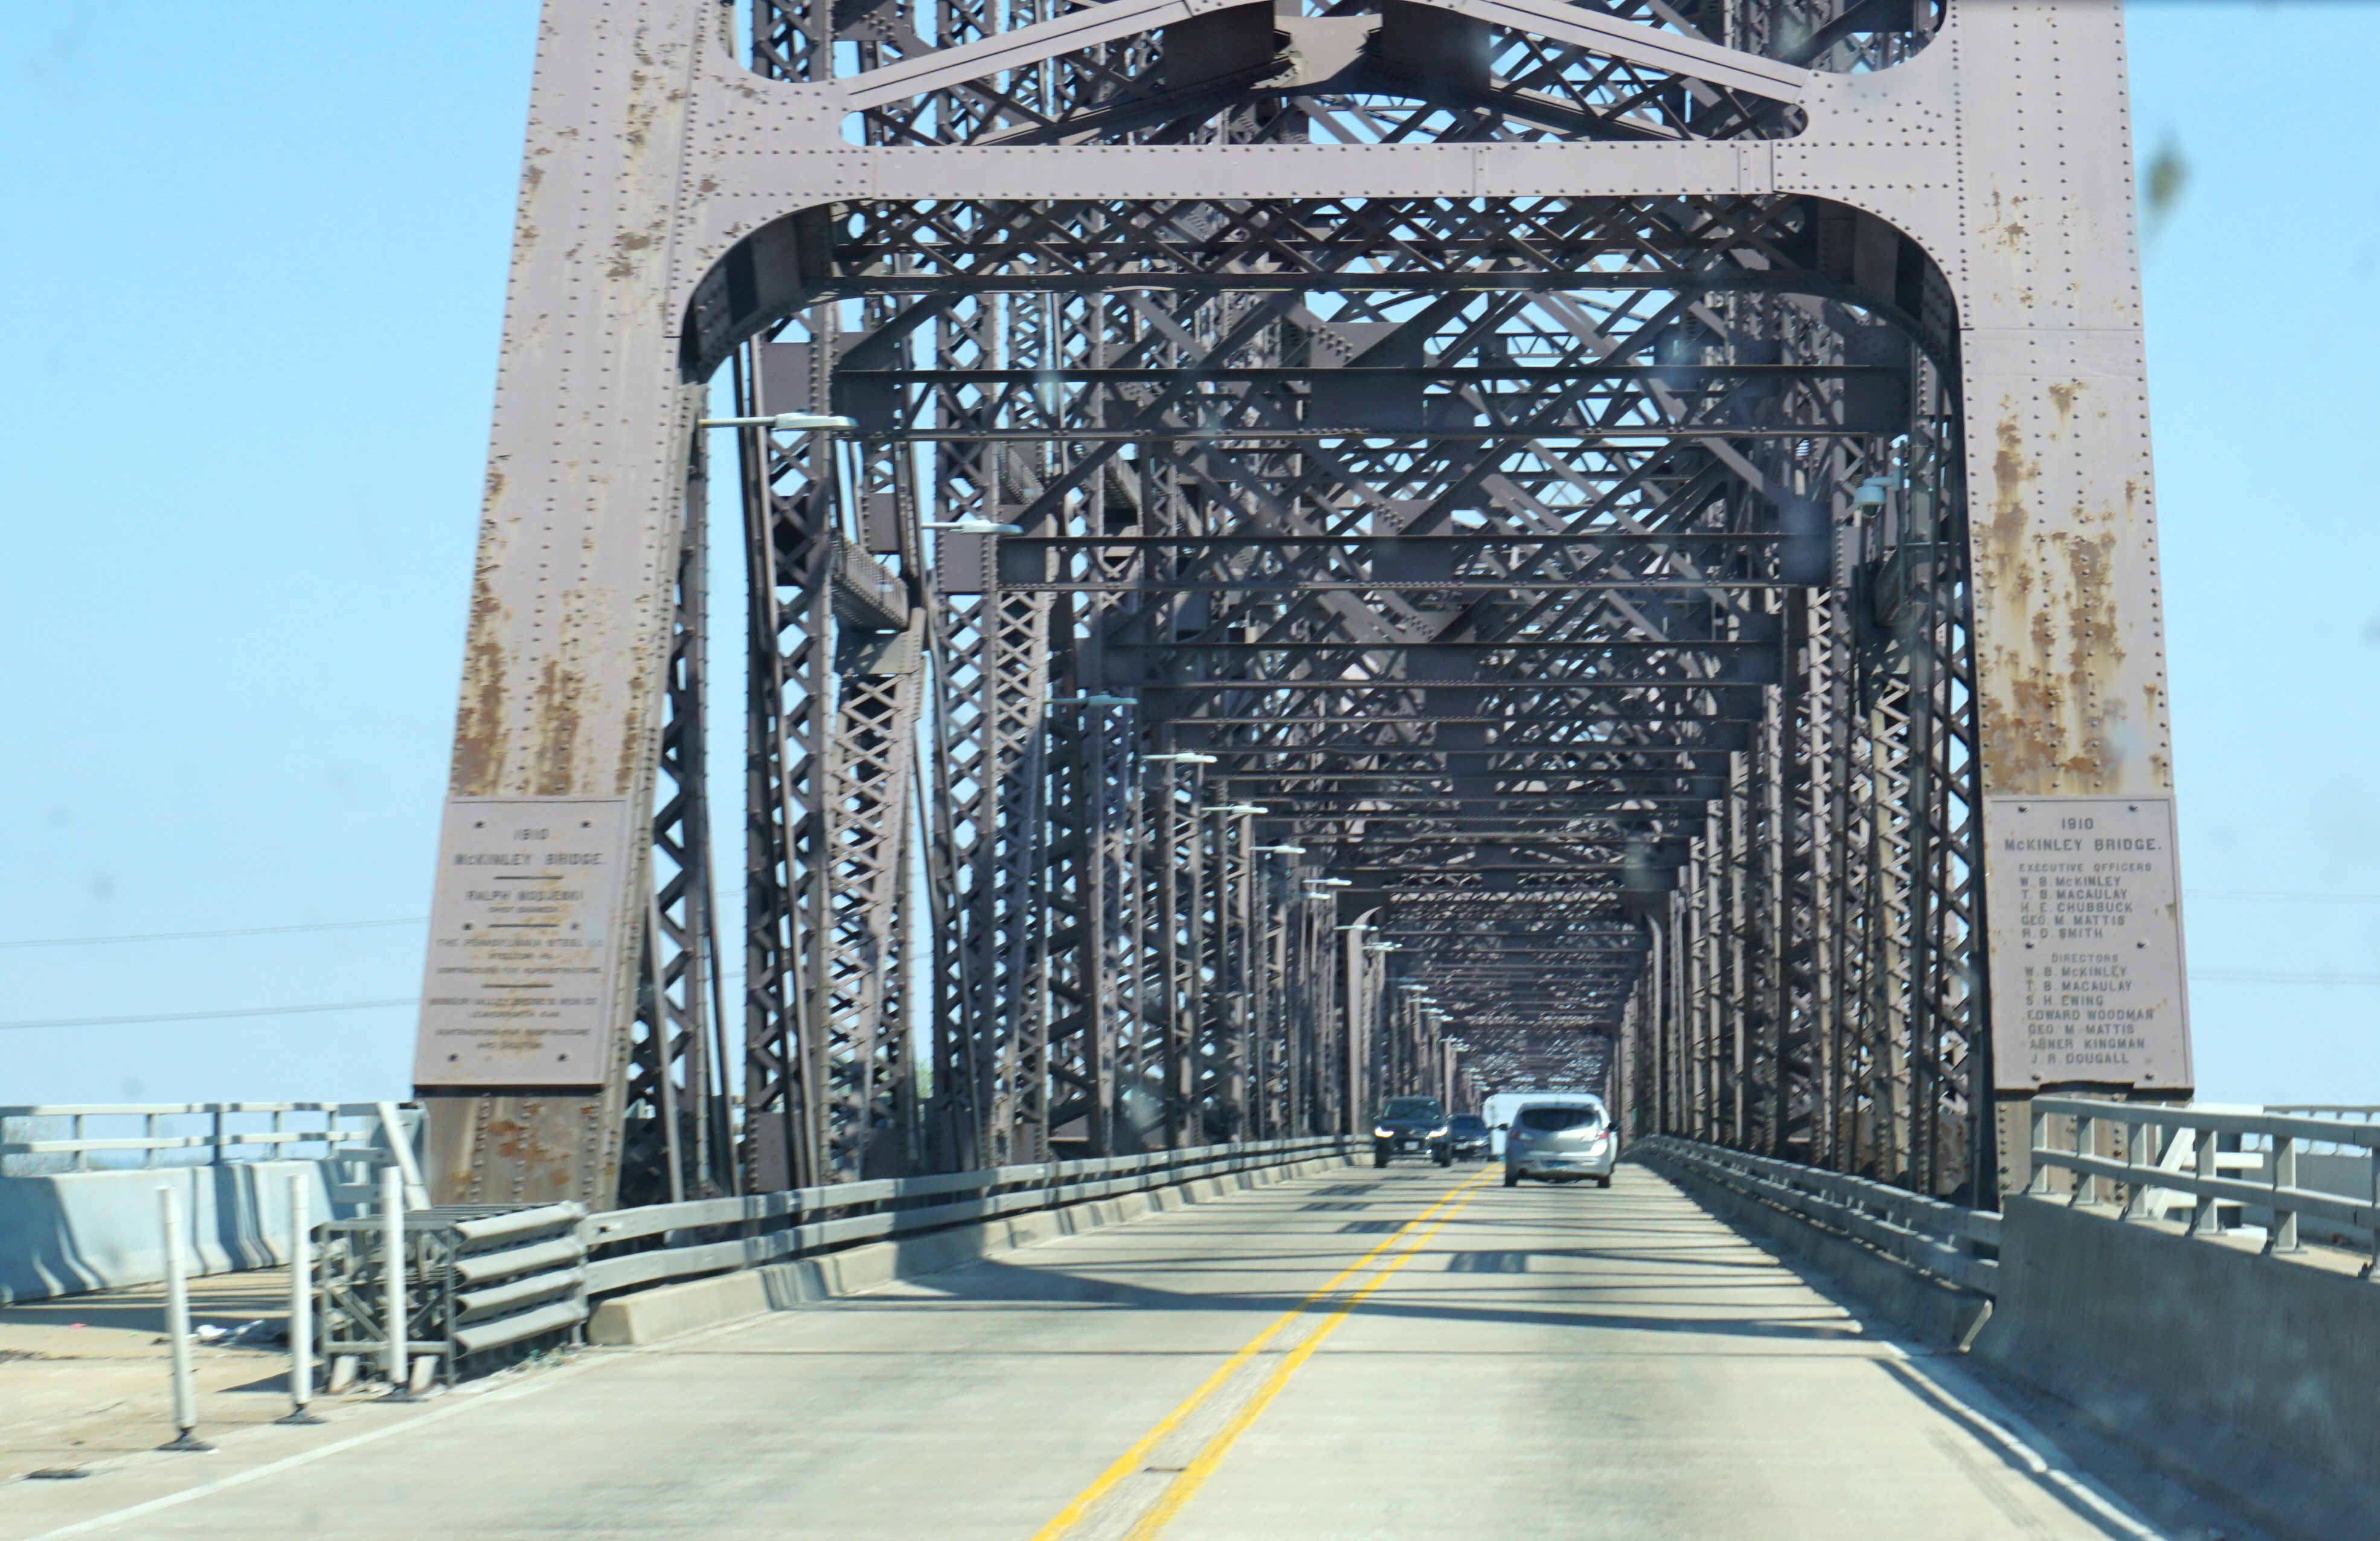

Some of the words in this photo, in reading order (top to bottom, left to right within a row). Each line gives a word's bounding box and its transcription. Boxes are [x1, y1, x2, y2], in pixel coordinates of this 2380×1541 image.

[2061, 817, 2094, 830] 1910
[2004, 838, 2083, 851] McKINLEY
[2094, 838, 2162, 851] BRIDGE.
[2018, 863, 2083, 872] EXECUTIVE
[2093, 863, 2152, 872] OFFICERS
[2055, 876, 2122, 887] McKINLEY
[2056, 889, 2128, 899] MACAULAY
[2056, 902, 2132, 913] CHUBBUCK
[2073, 915, 2126, 925] MATTIS
[2058, 927, 2103, 939] SMITH
[2051, 953, 2119, 963] DIRECTORS
[2061, 966, 2128, 977] McKINLEY
[2061, 980, 2132, 991] MACAULAY
[2061, 994, 2104, 1006] EWING
[2027, 1009, 2080, 1020] EDWARD
[2086, 1009, 2154, 1020] WOODMAN
[2085, 1024, 2135, 1035] MATTIS
[2029, 1038, 2074, 1049] ABNER
[2083, 1038, 2144, 1049] KINGMAN
[2065, 1053, 2129, 1064] DOUGALL
